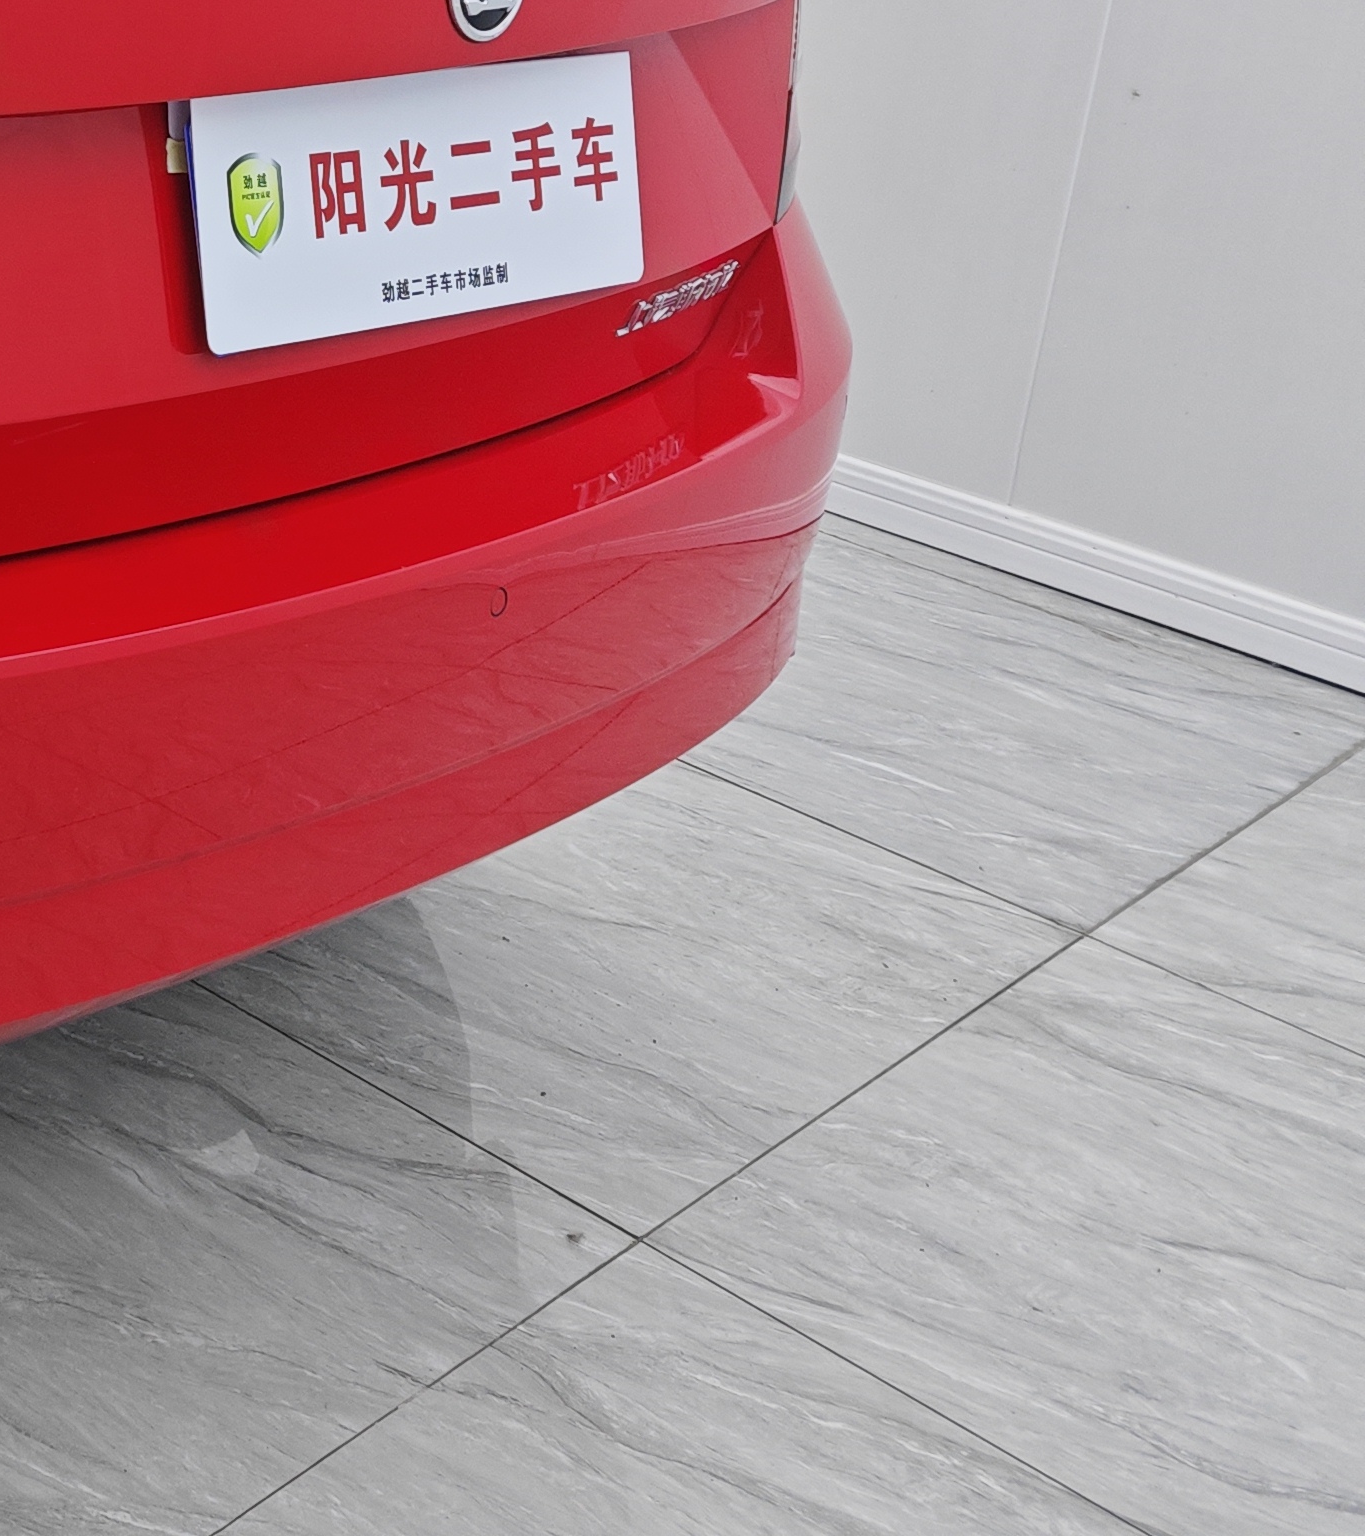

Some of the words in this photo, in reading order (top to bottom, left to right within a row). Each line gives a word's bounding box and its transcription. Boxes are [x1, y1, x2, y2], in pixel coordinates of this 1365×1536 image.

[307, 116, 619, 241] 阳光二手车
[381, 261, 509, 304] 劲越二手车市场监制
